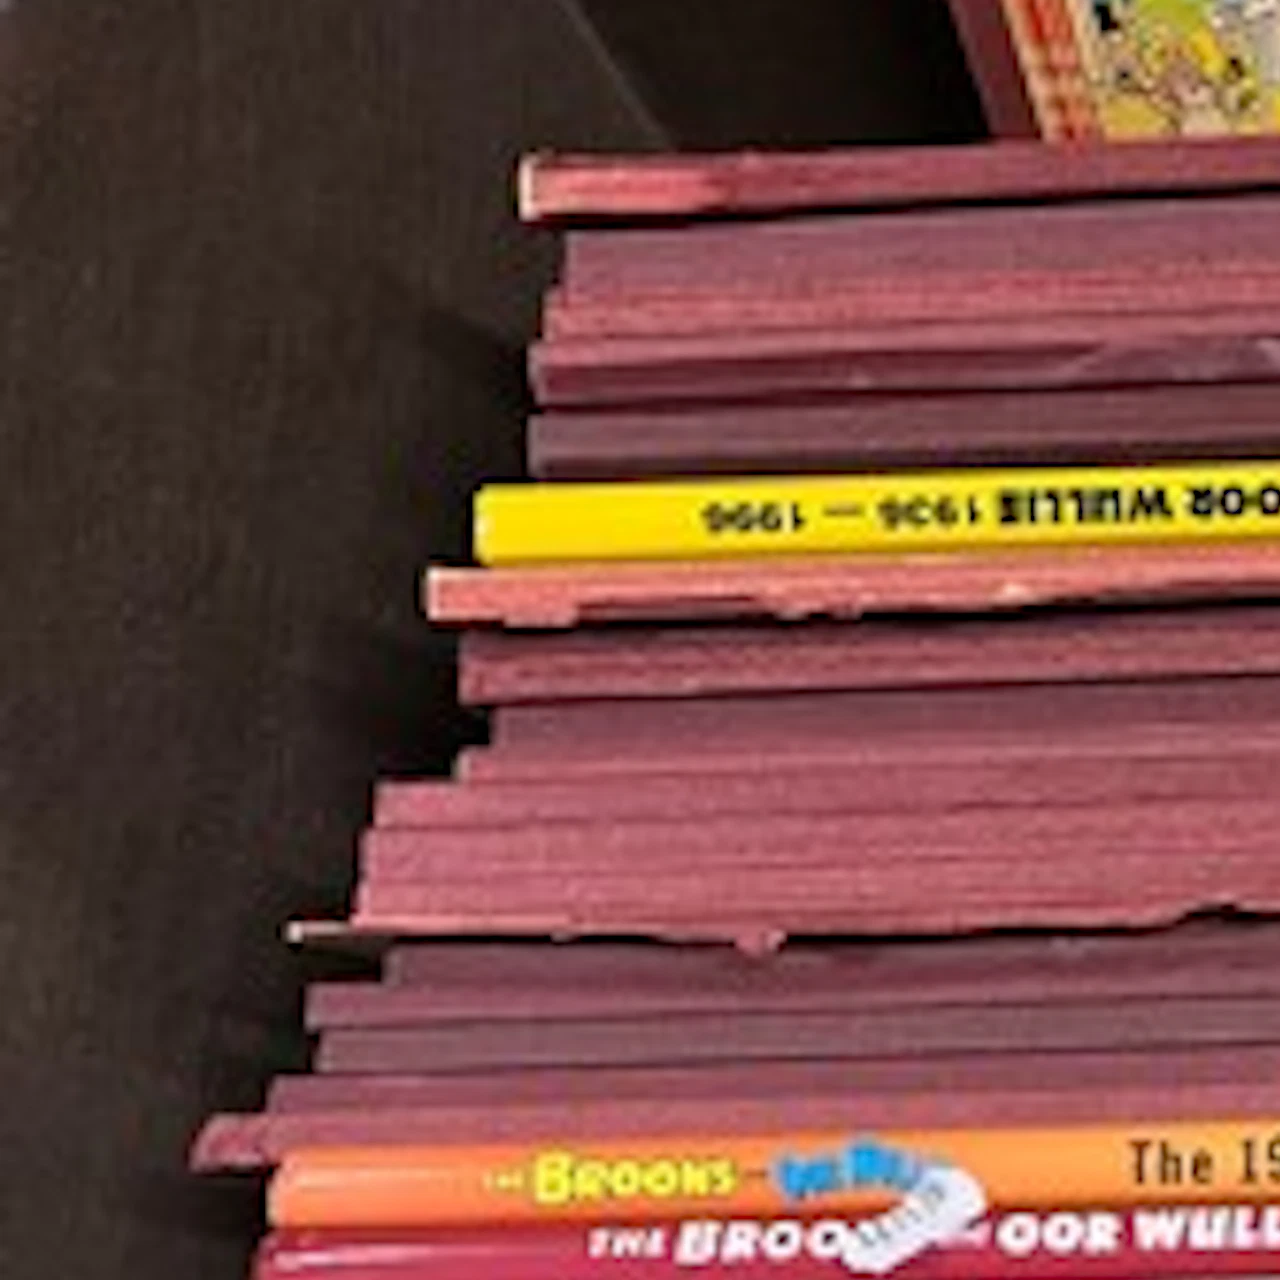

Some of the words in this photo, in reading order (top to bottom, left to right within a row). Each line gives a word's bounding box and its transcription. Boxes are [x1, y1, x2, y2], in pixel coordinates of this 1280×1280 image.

[998, 488, 1174, 524] WULLIE
[533, 1150, 738, 1204] BROONS
[1128, 1138, 1214, 1186] The
[587, 1228, 667, 1259] THE
[673, 1220, 880, 1268] BROO
[997, 1210, 1121, 1255] OOR
